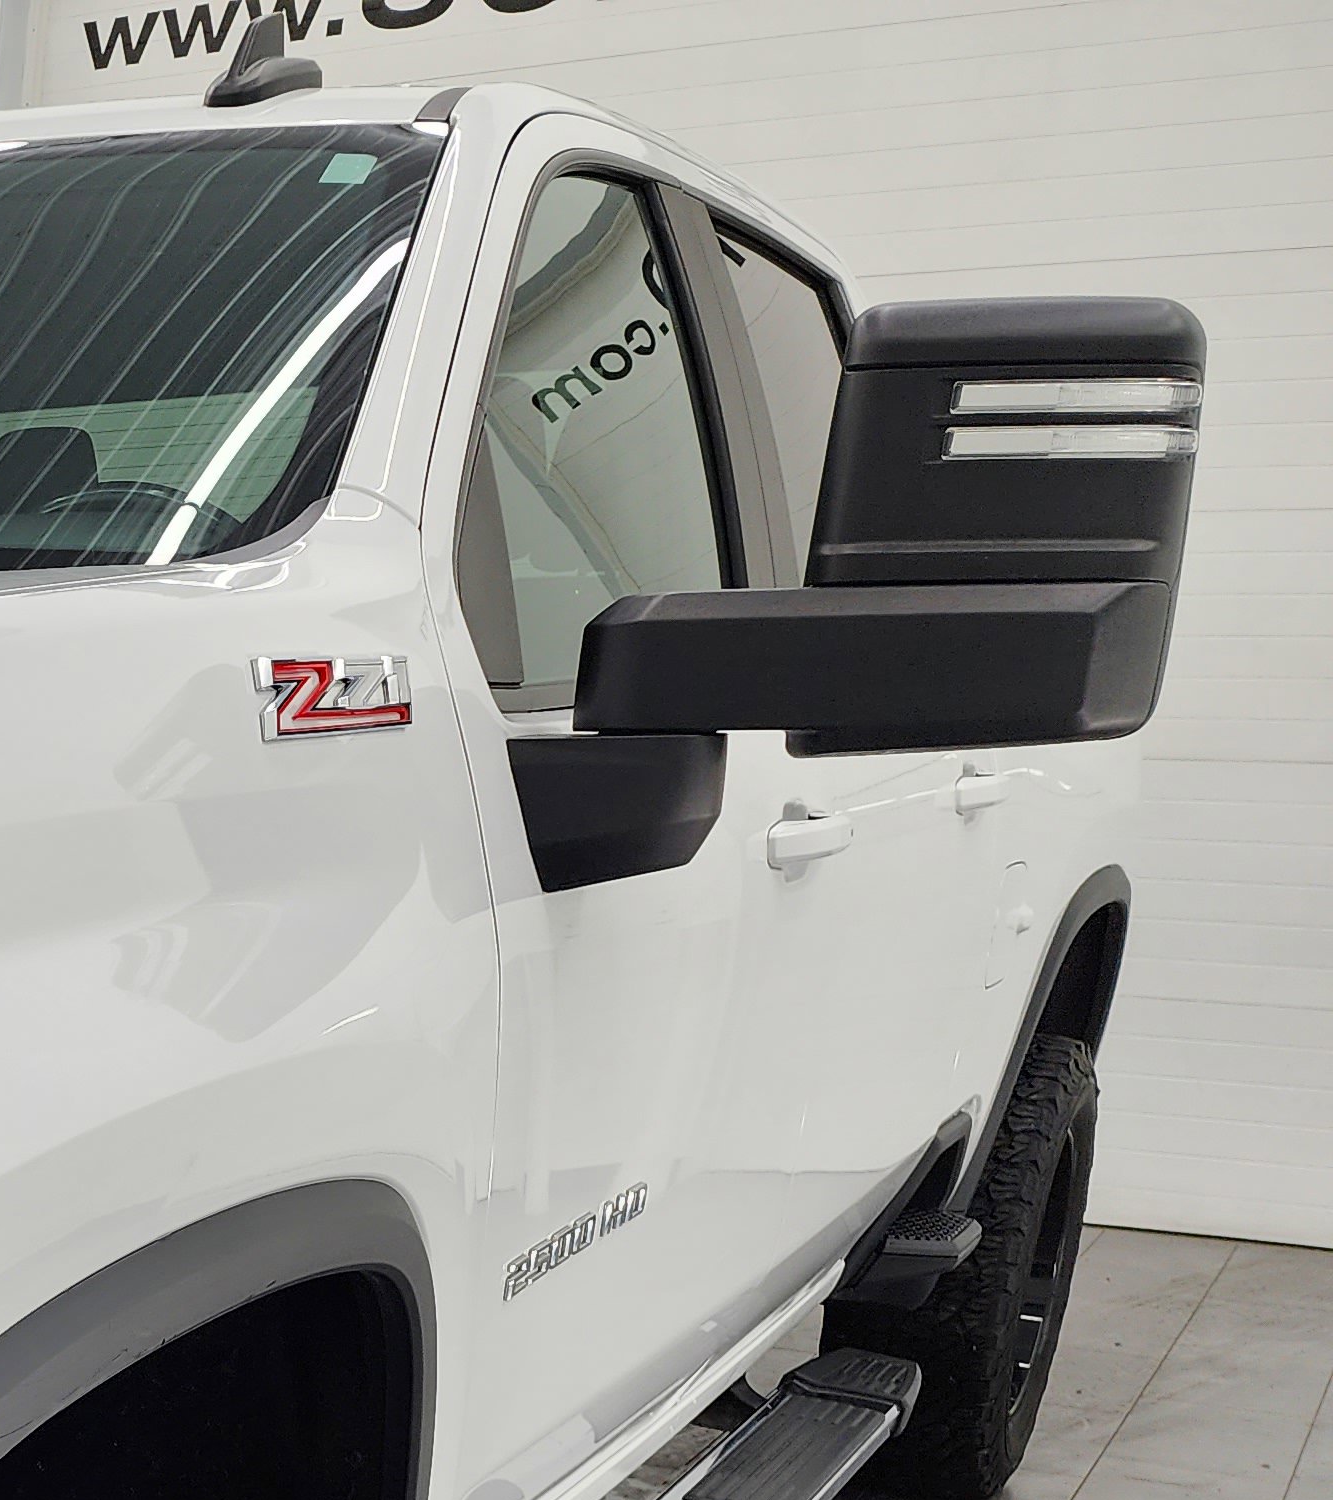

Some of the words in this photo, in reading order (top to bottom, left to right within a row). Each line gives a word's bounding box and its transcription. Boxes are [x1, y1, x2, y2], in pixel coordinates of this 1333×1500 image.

[83, 0, 559, 70] www.
[250, 655, 412, 742] Z71
[501, 1211, 596, 1301] 2500
[599, 1182, 647, 1237] HD
